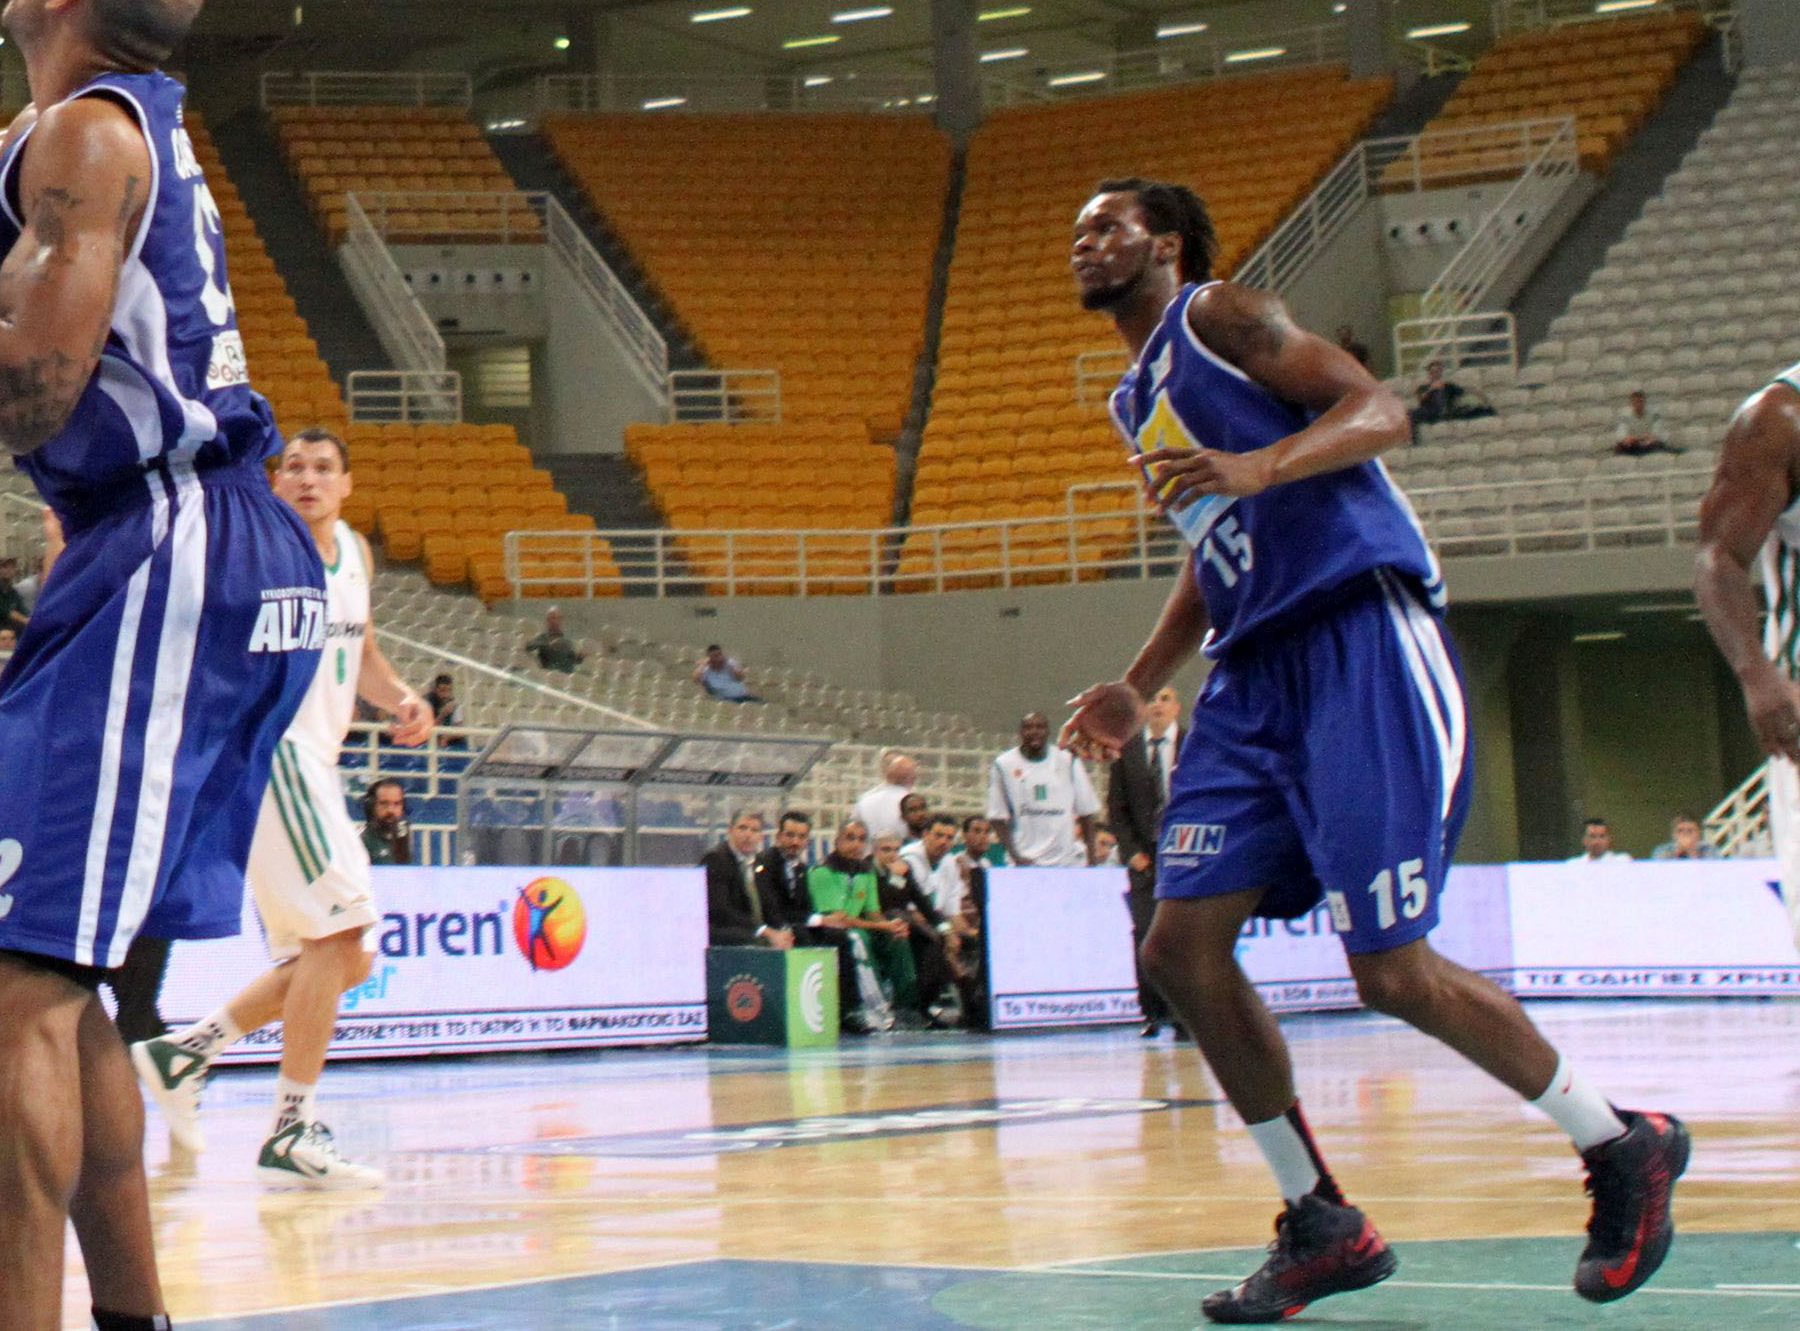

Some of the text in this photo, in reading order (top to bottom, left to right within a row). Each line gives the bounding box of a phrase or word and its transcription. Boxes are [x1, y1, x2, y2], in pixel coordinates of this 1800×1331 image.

[1203, 516, 1254, 588] 15
[1160, 824, 1226, 855] AVIN
[1368, 857, 1429, 931] 15
[379, 912, 505, 957] aren
